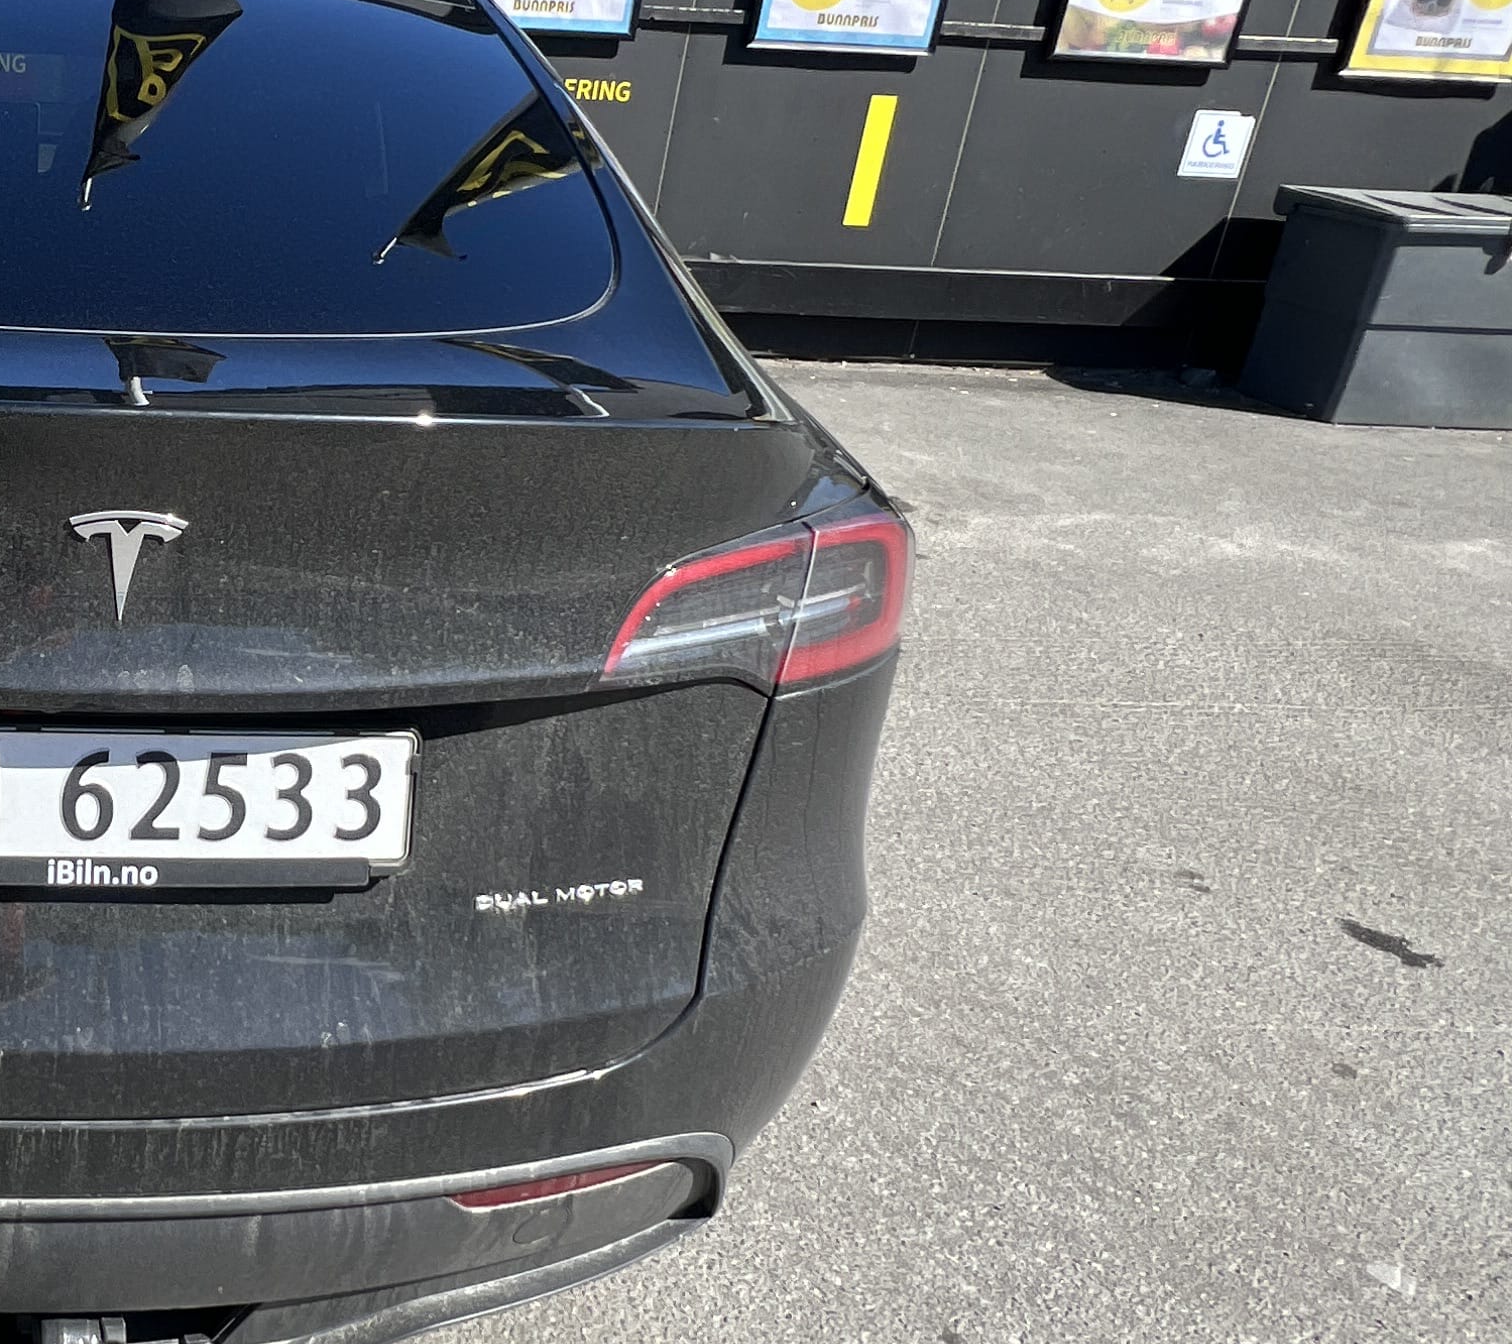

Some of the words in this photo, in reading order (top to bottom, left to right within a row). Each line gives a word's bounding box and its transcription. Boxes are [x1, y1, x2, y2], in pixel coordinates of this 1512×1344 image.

[817, 12, 879, 27] BUNNPRIS
[60, 750, 383, 841] 62533
[47, 859, 159, 886] iBiln.no
[555, 878, 643, 904] MOTOR
